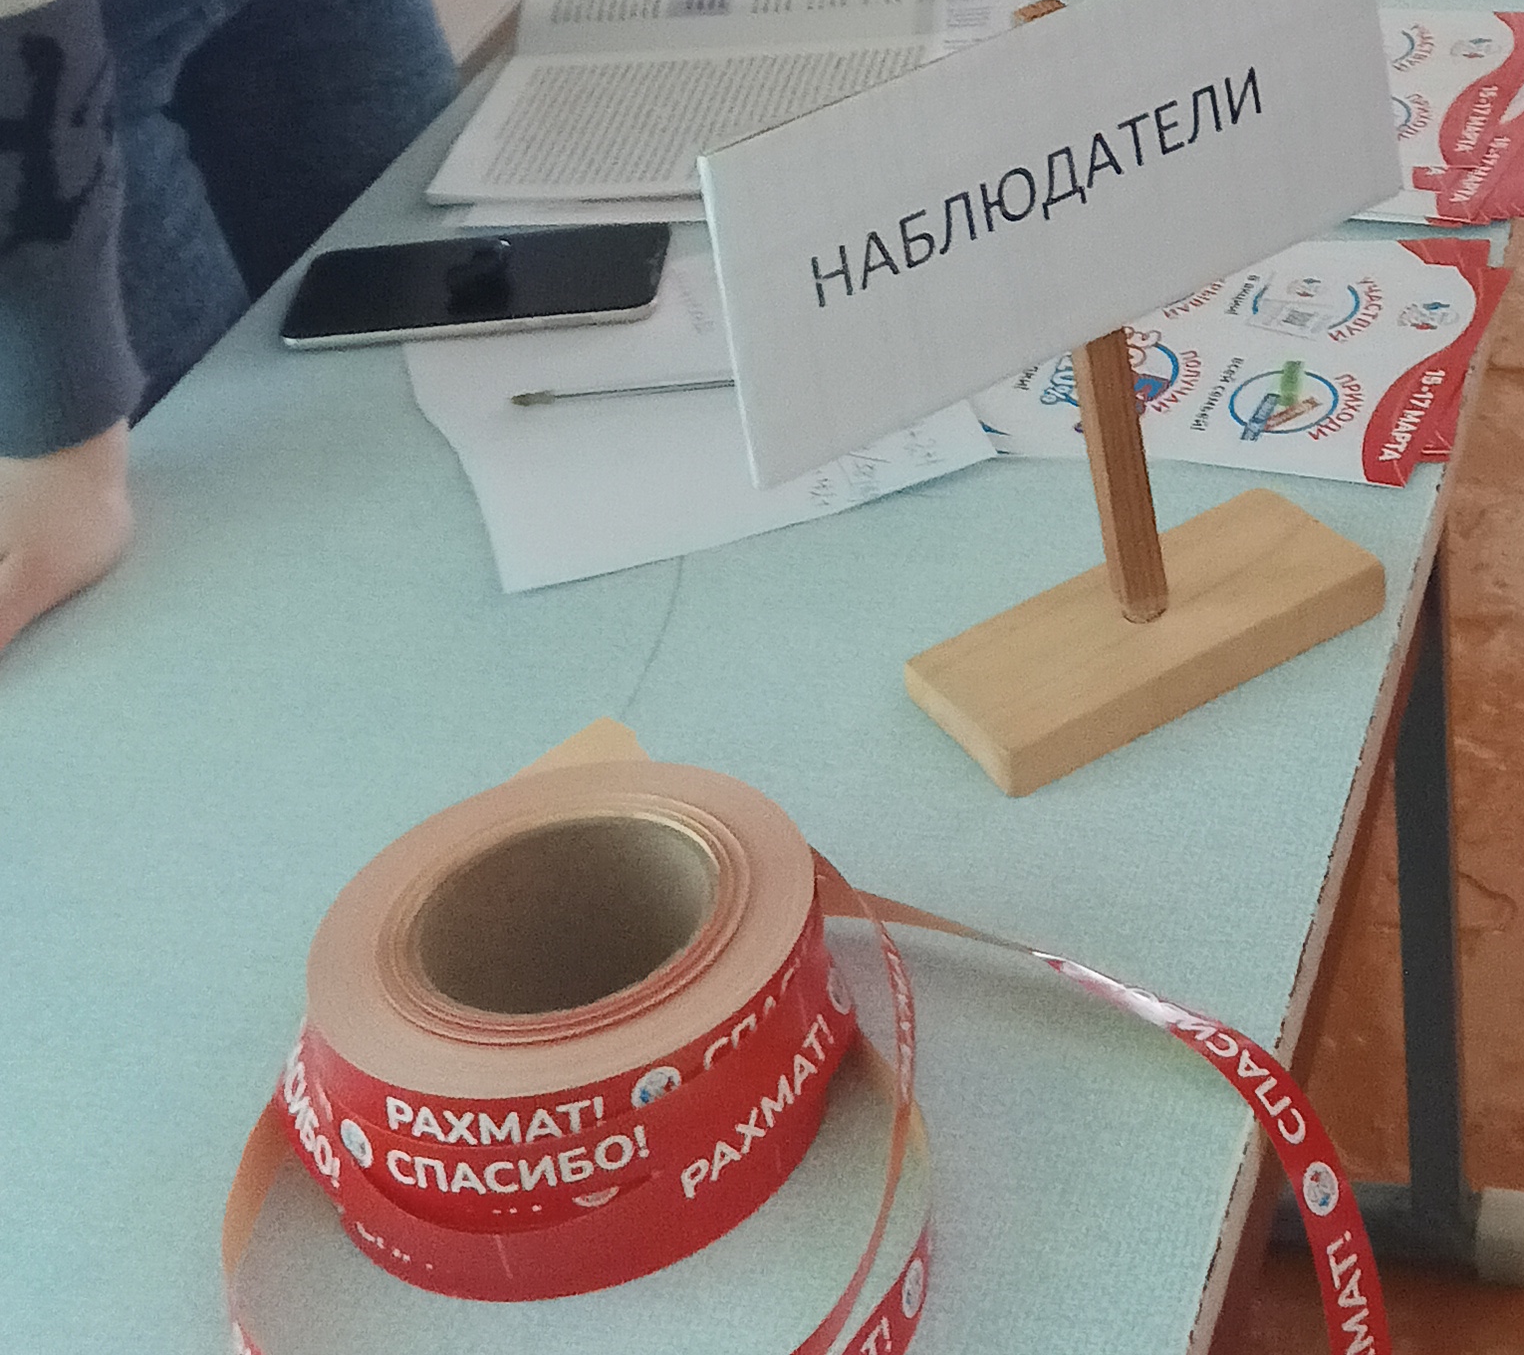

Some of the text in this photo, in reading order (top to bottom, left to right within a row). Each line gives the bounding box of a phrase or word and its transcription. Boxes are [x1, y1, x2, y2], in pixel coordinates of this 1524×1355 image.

[811, 66, 1263, 309] НАБЛЮДАТЕЛИ
[1307, 372, 1365, 441] ПРИХОДИ
[1378, 408, 1424, 462] МАРТА
[385, 1094, 606, 1147] РАХМАТ!
[680, 1013, 836, 1199] РАХМАТ!
[385, 1124, 651, 1197] СПАСИБО!
